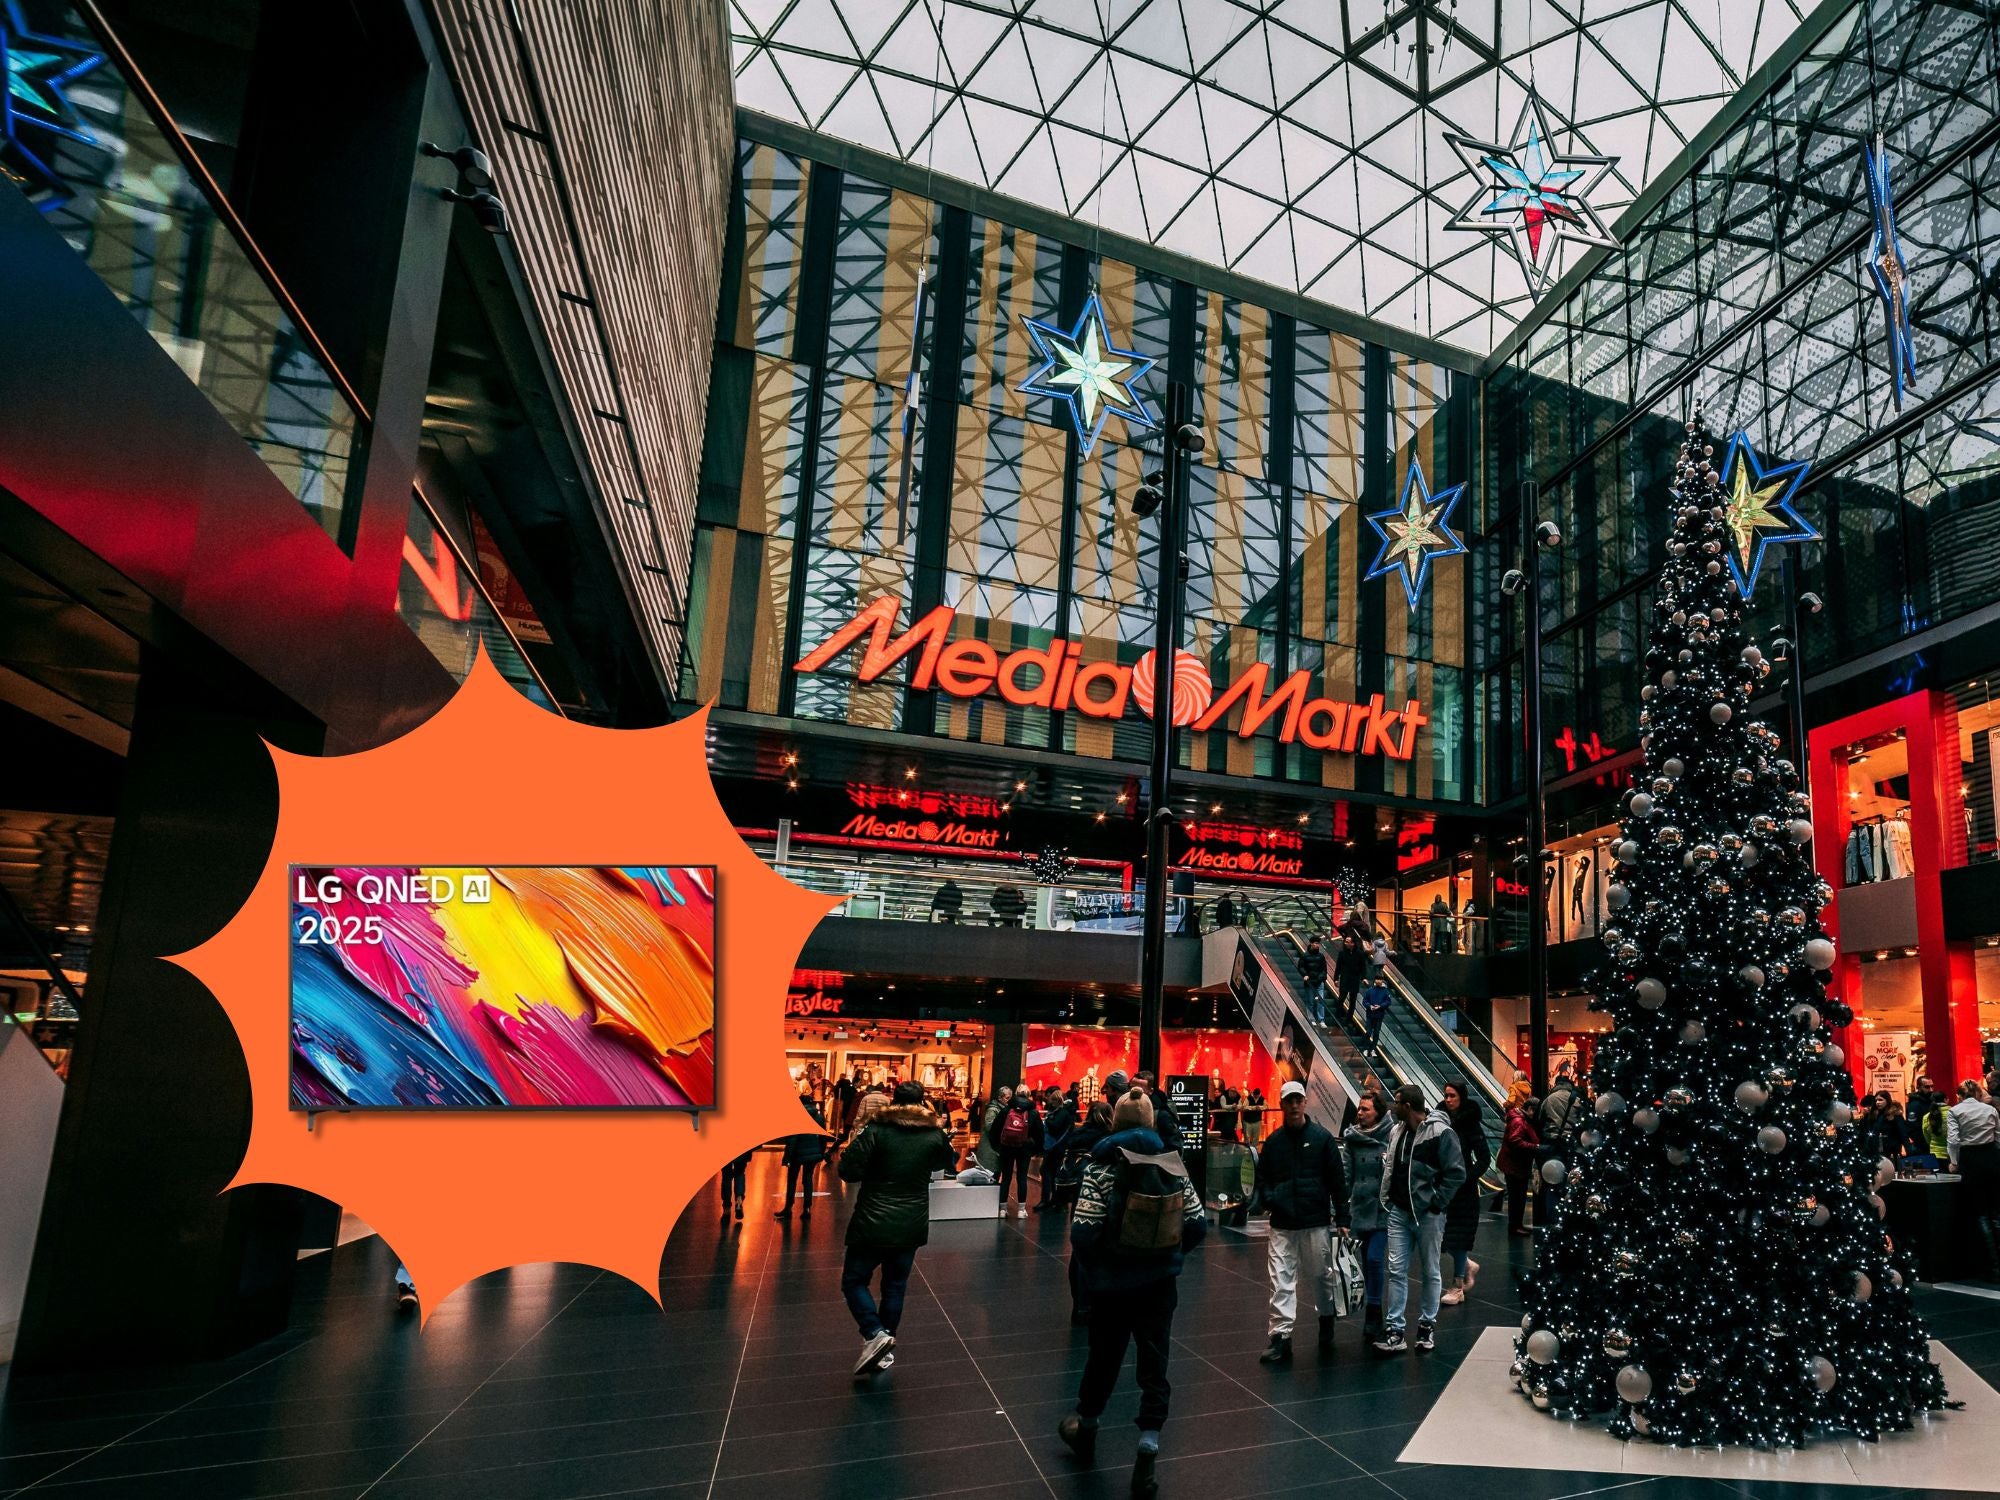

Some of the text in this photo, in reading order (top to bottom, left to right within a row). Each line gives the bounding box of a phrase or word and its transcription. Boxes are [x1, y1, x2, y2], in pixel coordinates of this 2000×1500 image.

[793, 596, 1134, 720] Media
[1191, 661, 1428, 761] Markt
[841, 813, 1001, 847] Media Markt
[1178, 847, 1303, 875] Media Markt
